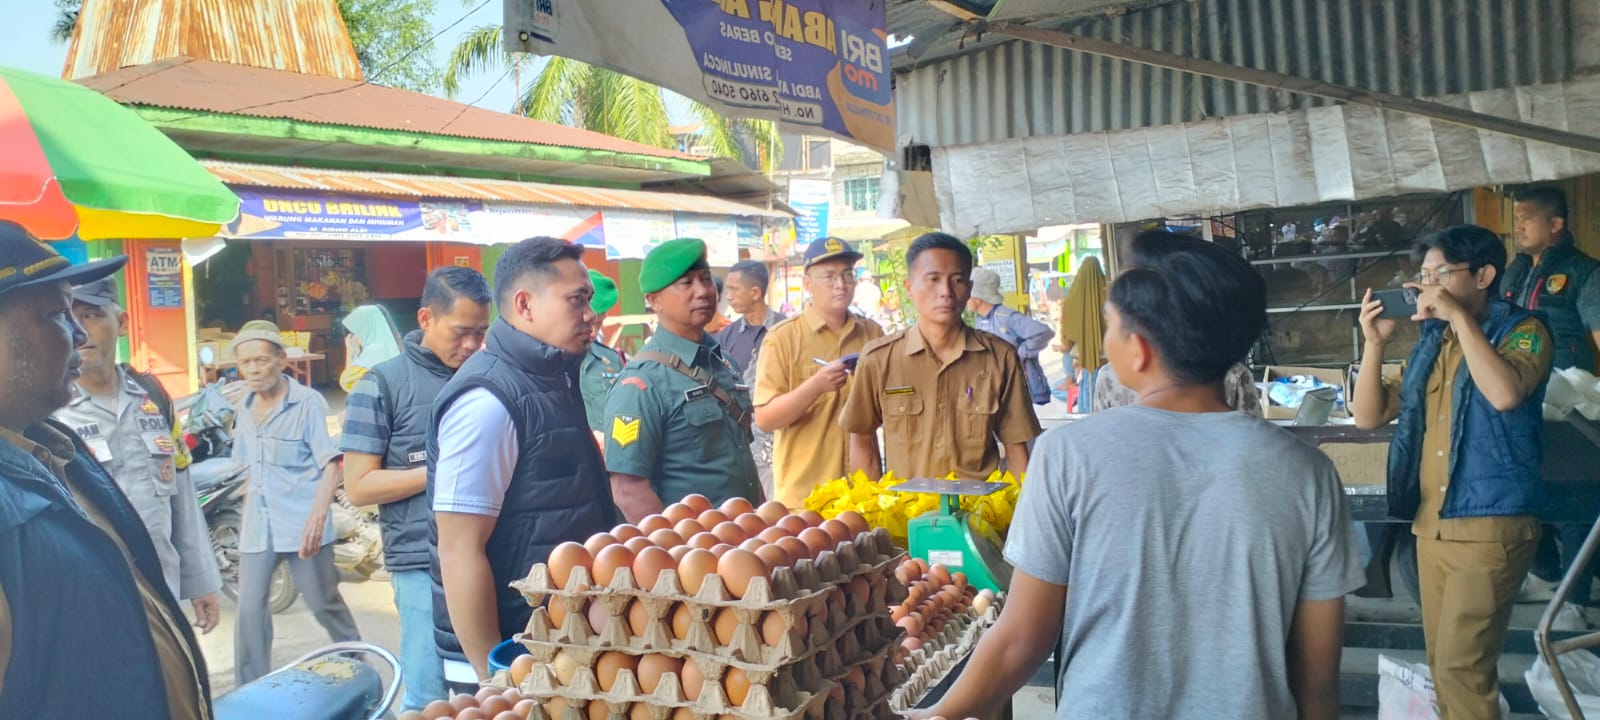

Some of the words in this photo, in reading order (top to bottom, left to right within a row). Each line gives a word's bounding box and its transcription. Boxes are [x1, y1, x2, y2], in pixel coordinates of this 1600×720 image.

[263, 198, 322, 215] UNCU
[325, 201, 403, 218] BRILINK
[263, 215, 302, 223] WARUNG
[304, 216, 347, 225] MAKANAN
[348, 217, 366, 225] DAN
[366, 218, 405, 226] MINUMAN
[151, 257, 178, 268] ATM
